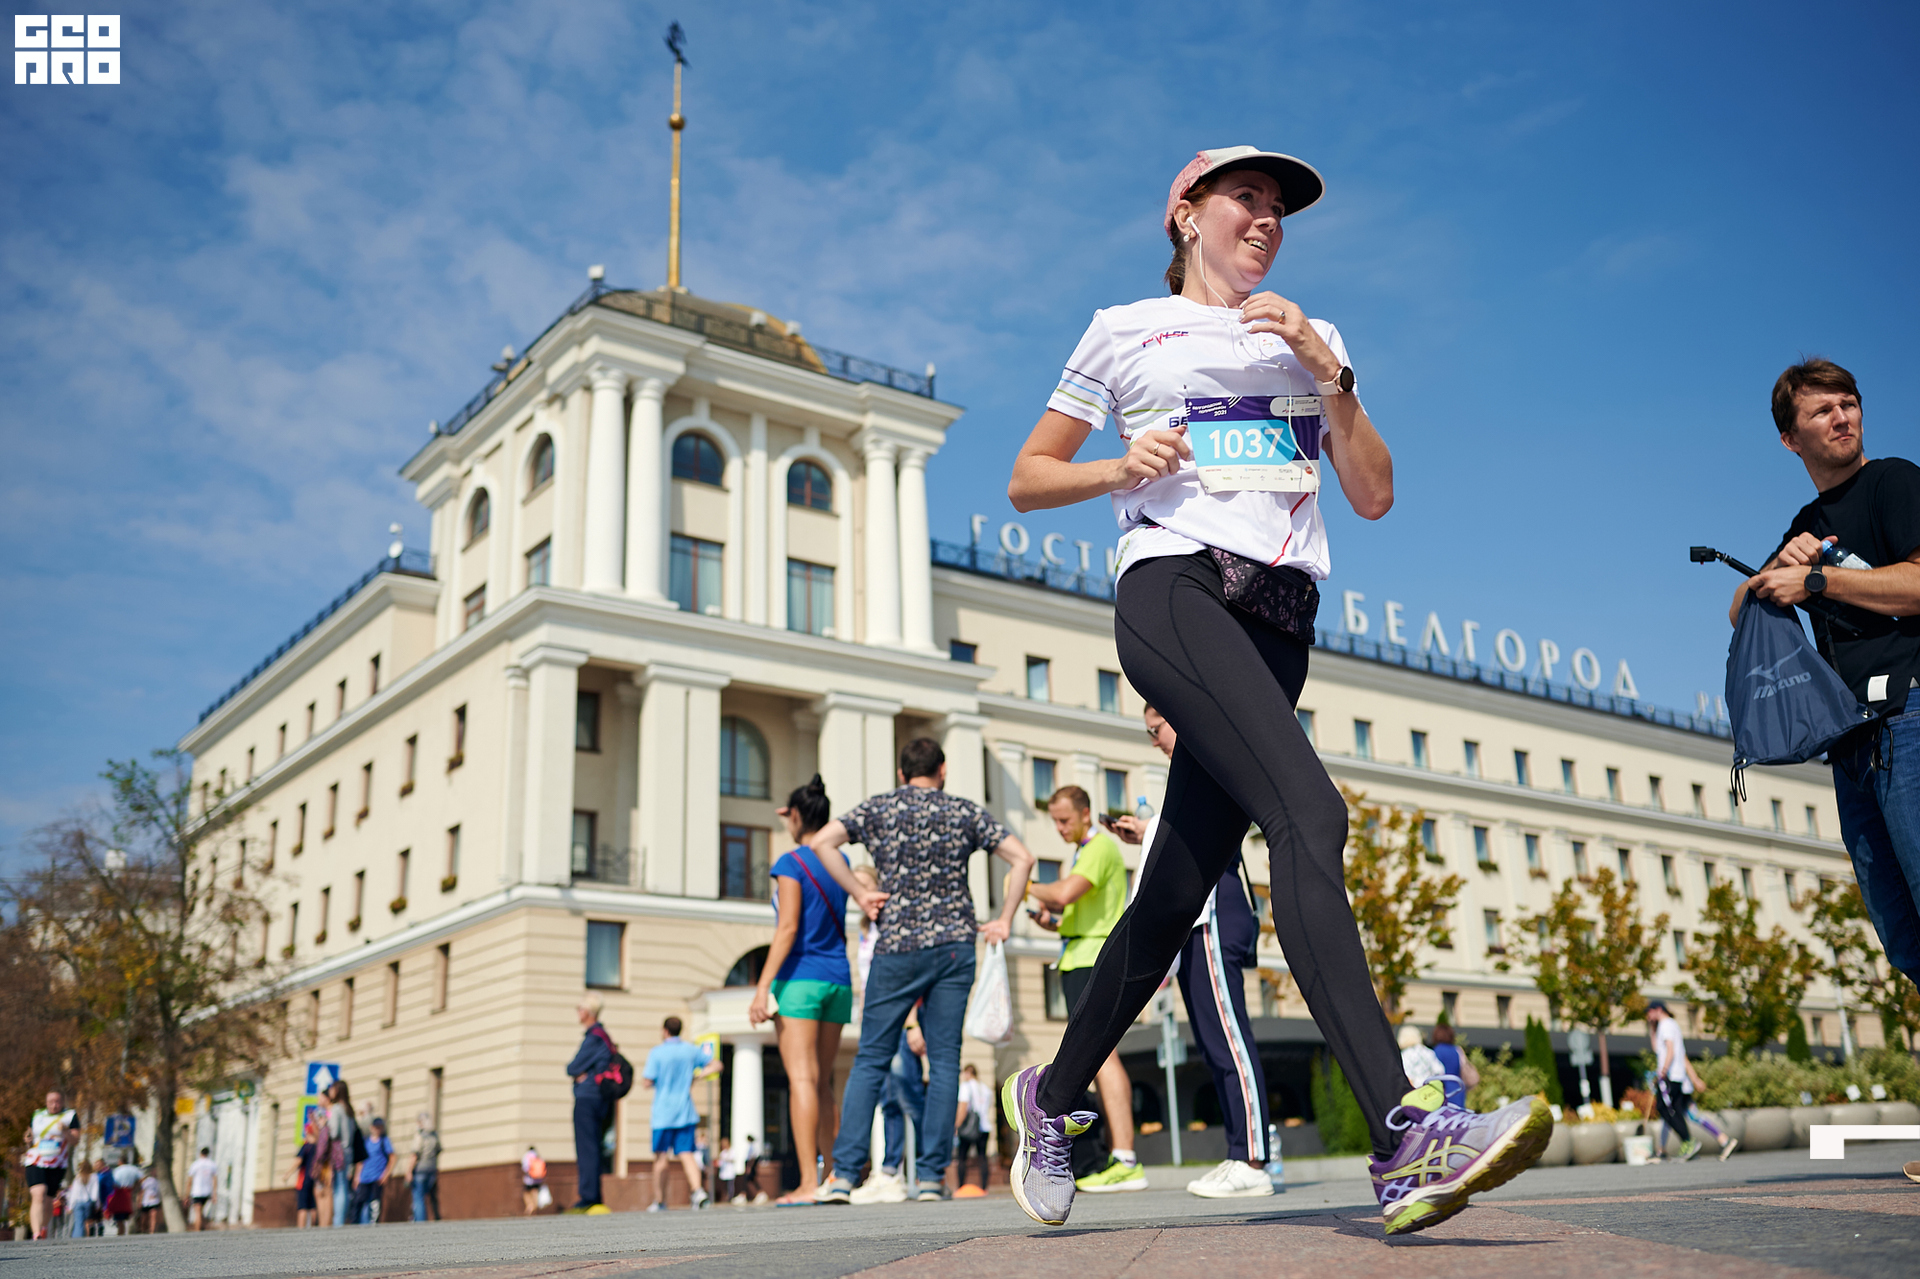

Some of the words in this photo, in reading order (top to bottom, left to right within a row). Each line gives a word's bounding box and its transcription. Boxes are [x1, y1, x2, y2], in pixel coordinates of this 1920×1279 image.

[1214, 409, 1227, 417] 2021
[1208, 427, 1284, 459] 1037
[1342, 589, 1640, 700] БЕЛГОРОД
